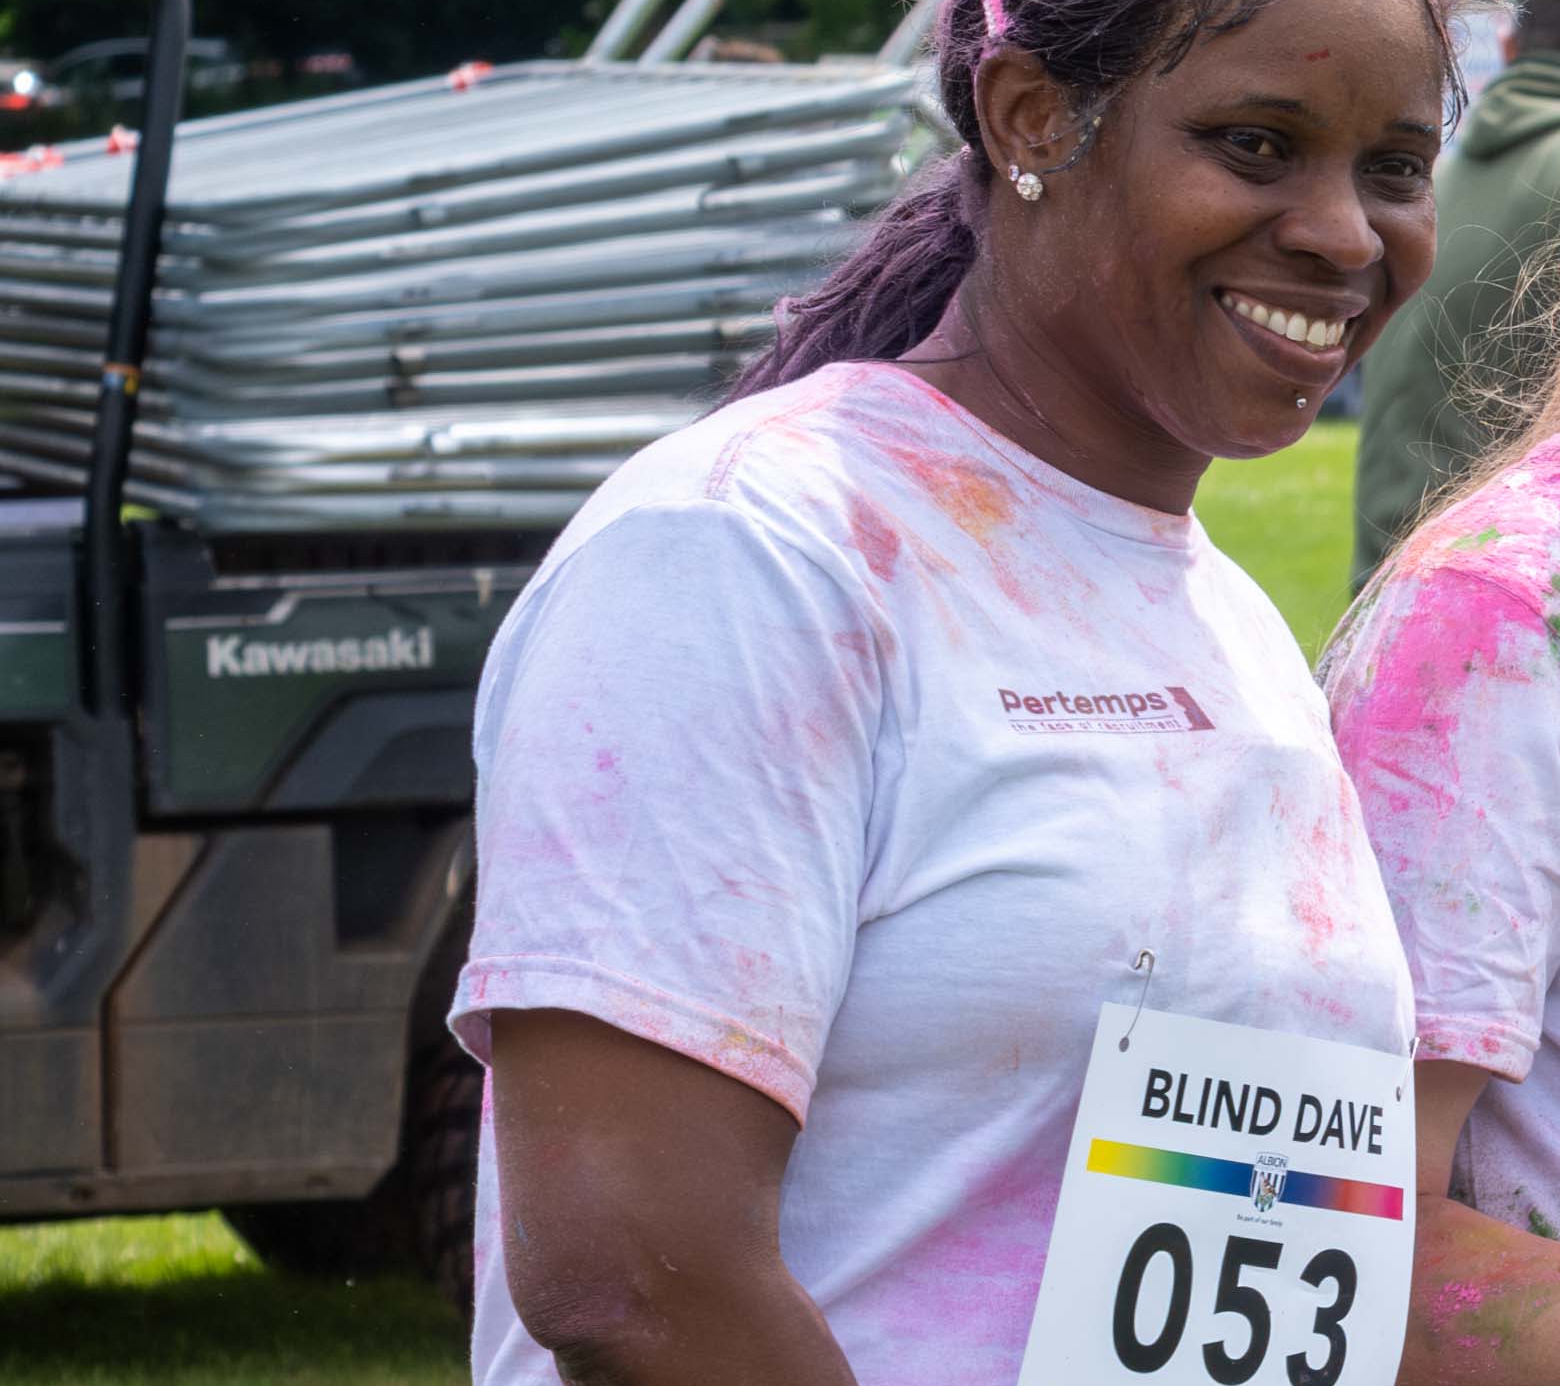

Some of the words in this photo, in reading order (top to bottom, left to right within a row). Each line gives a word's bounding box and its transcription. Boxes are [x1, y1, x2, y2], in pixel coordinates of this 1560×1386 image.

[206, 627, 433, 679] Kawasaki
[998, 688, 1168, 717] Pertemps
[1141, 1068, 1282, 1136] BLIND
[1293, 1094, 1383, 1155] DAVE
